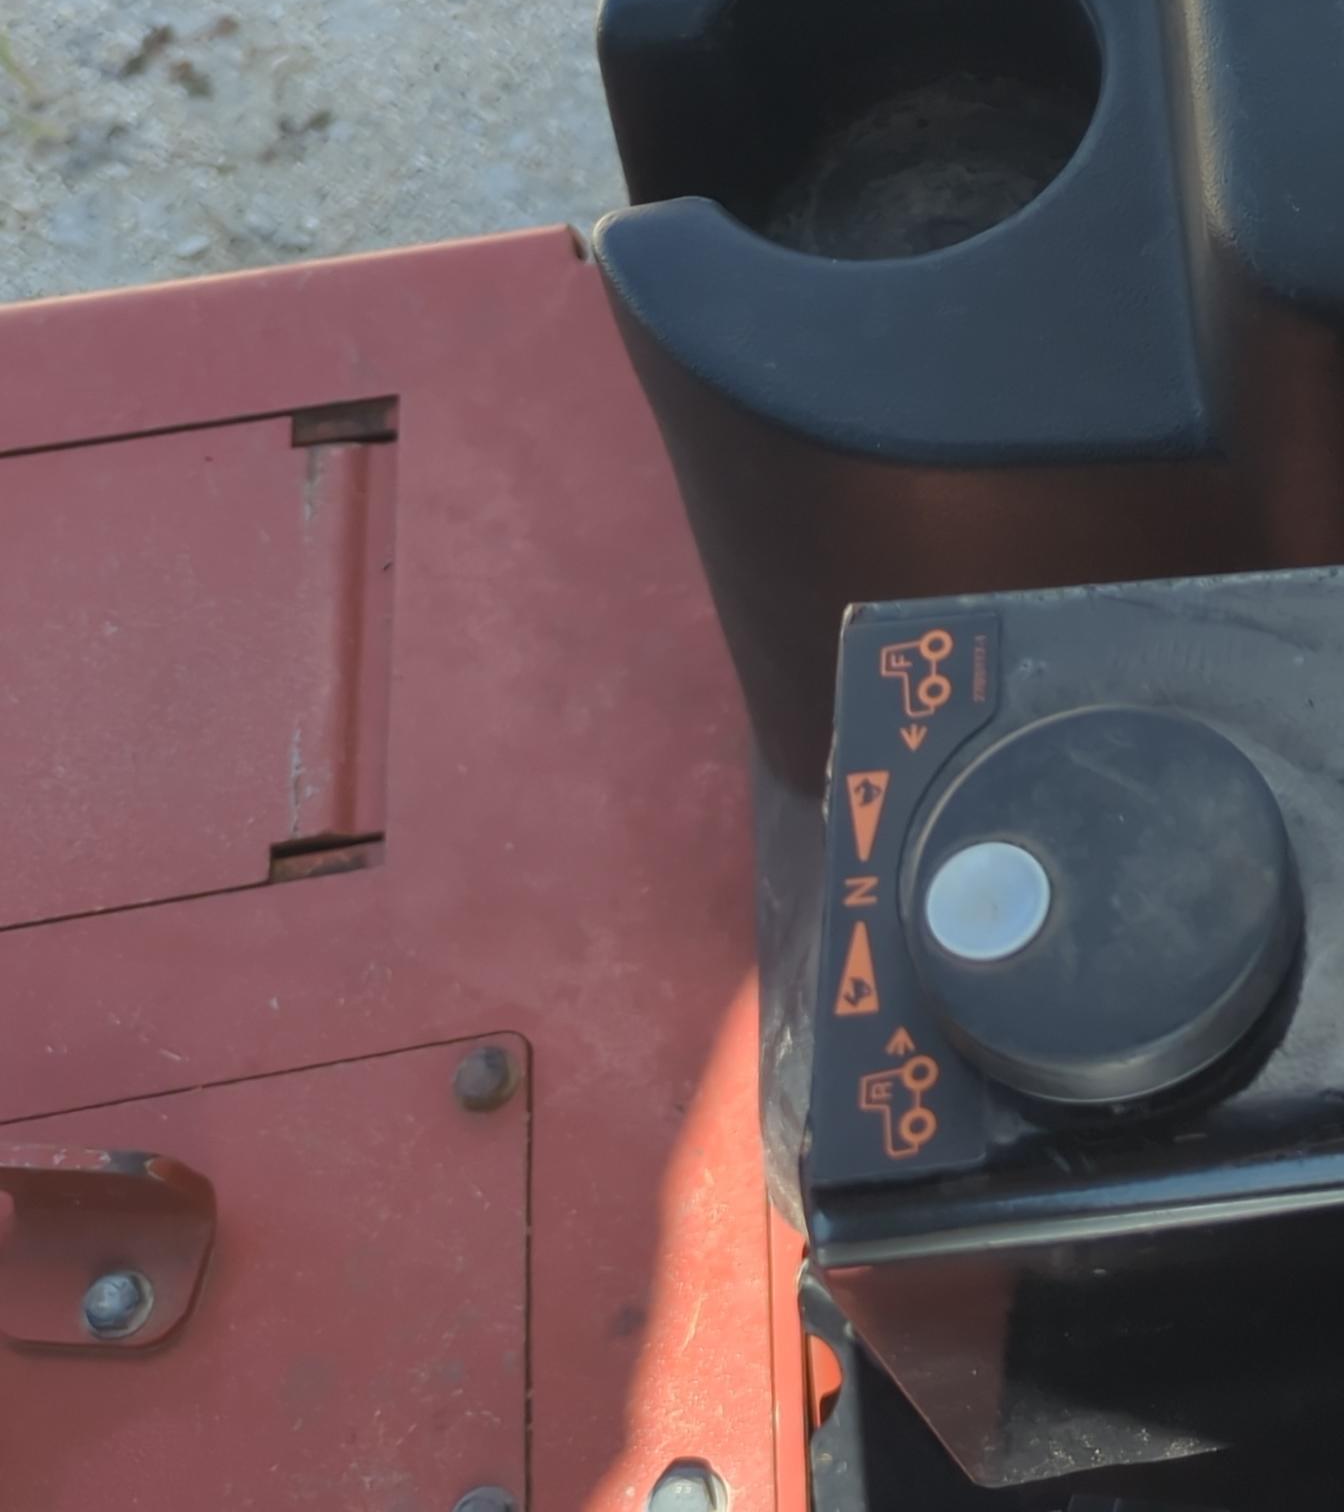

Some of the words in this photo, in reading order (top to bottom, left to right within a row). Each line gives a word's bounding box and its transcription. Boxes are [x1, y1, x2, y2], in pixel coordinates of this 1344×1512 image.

[891, 653, 912, 668] F
[844, 876, 878, 906] N
[871, 1081, 894, 1099] R
